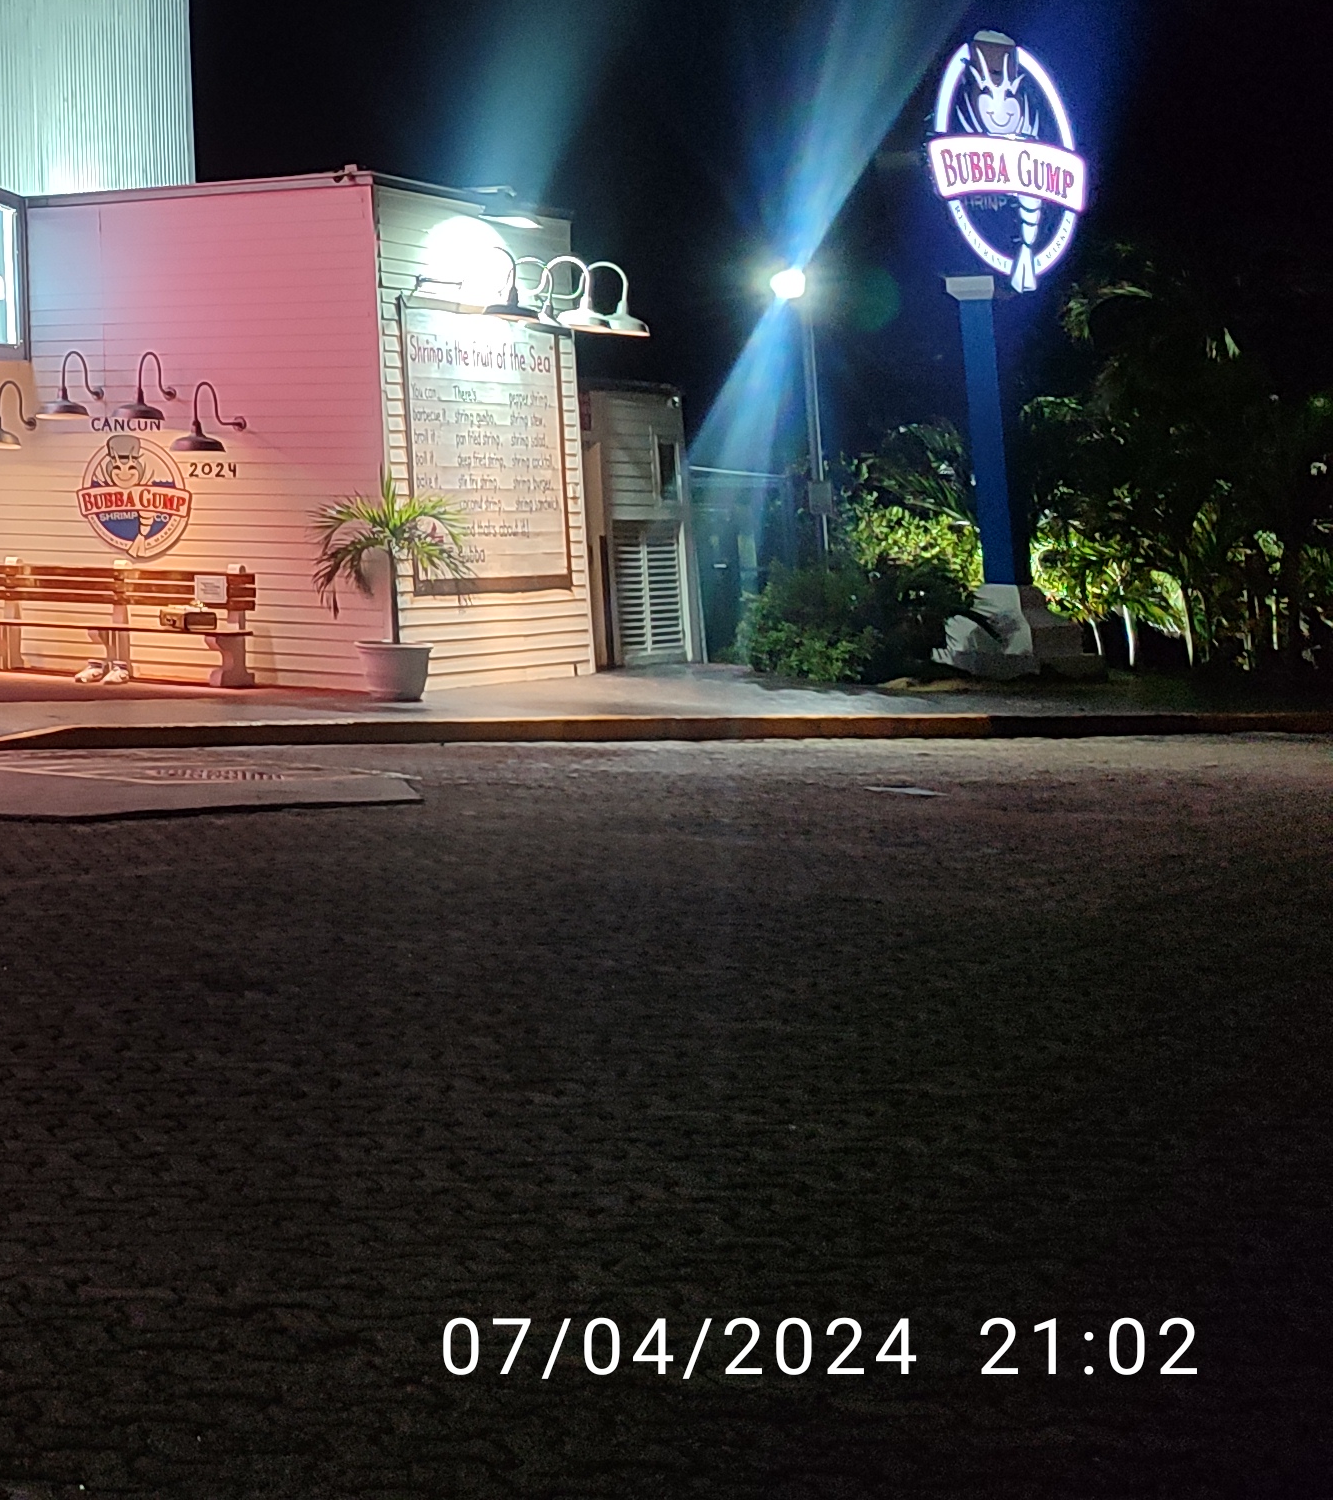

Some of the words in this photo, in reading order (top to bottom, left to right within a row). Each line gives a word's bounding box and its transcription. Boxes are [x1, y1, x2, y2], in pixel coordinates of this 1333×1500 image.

[940, 149, 1011, 187] BUBBA
[1017, 150, 1075, 199] GUMP
[410, 334, 444, 369] Shrimp
[445, 341, 454, 365] is
[454, 340, 470, 367] the
[496, 343, 507, 370] of
[509, 344, 527, 371] the
[411, 382, 423, 399] You
[189, 462, 237, 478] 2024
[83, 491, 136, 512] BUBBA
[138, 488, 187, 512] GUMP
[99, 511, 138, 522] SHRIMP
